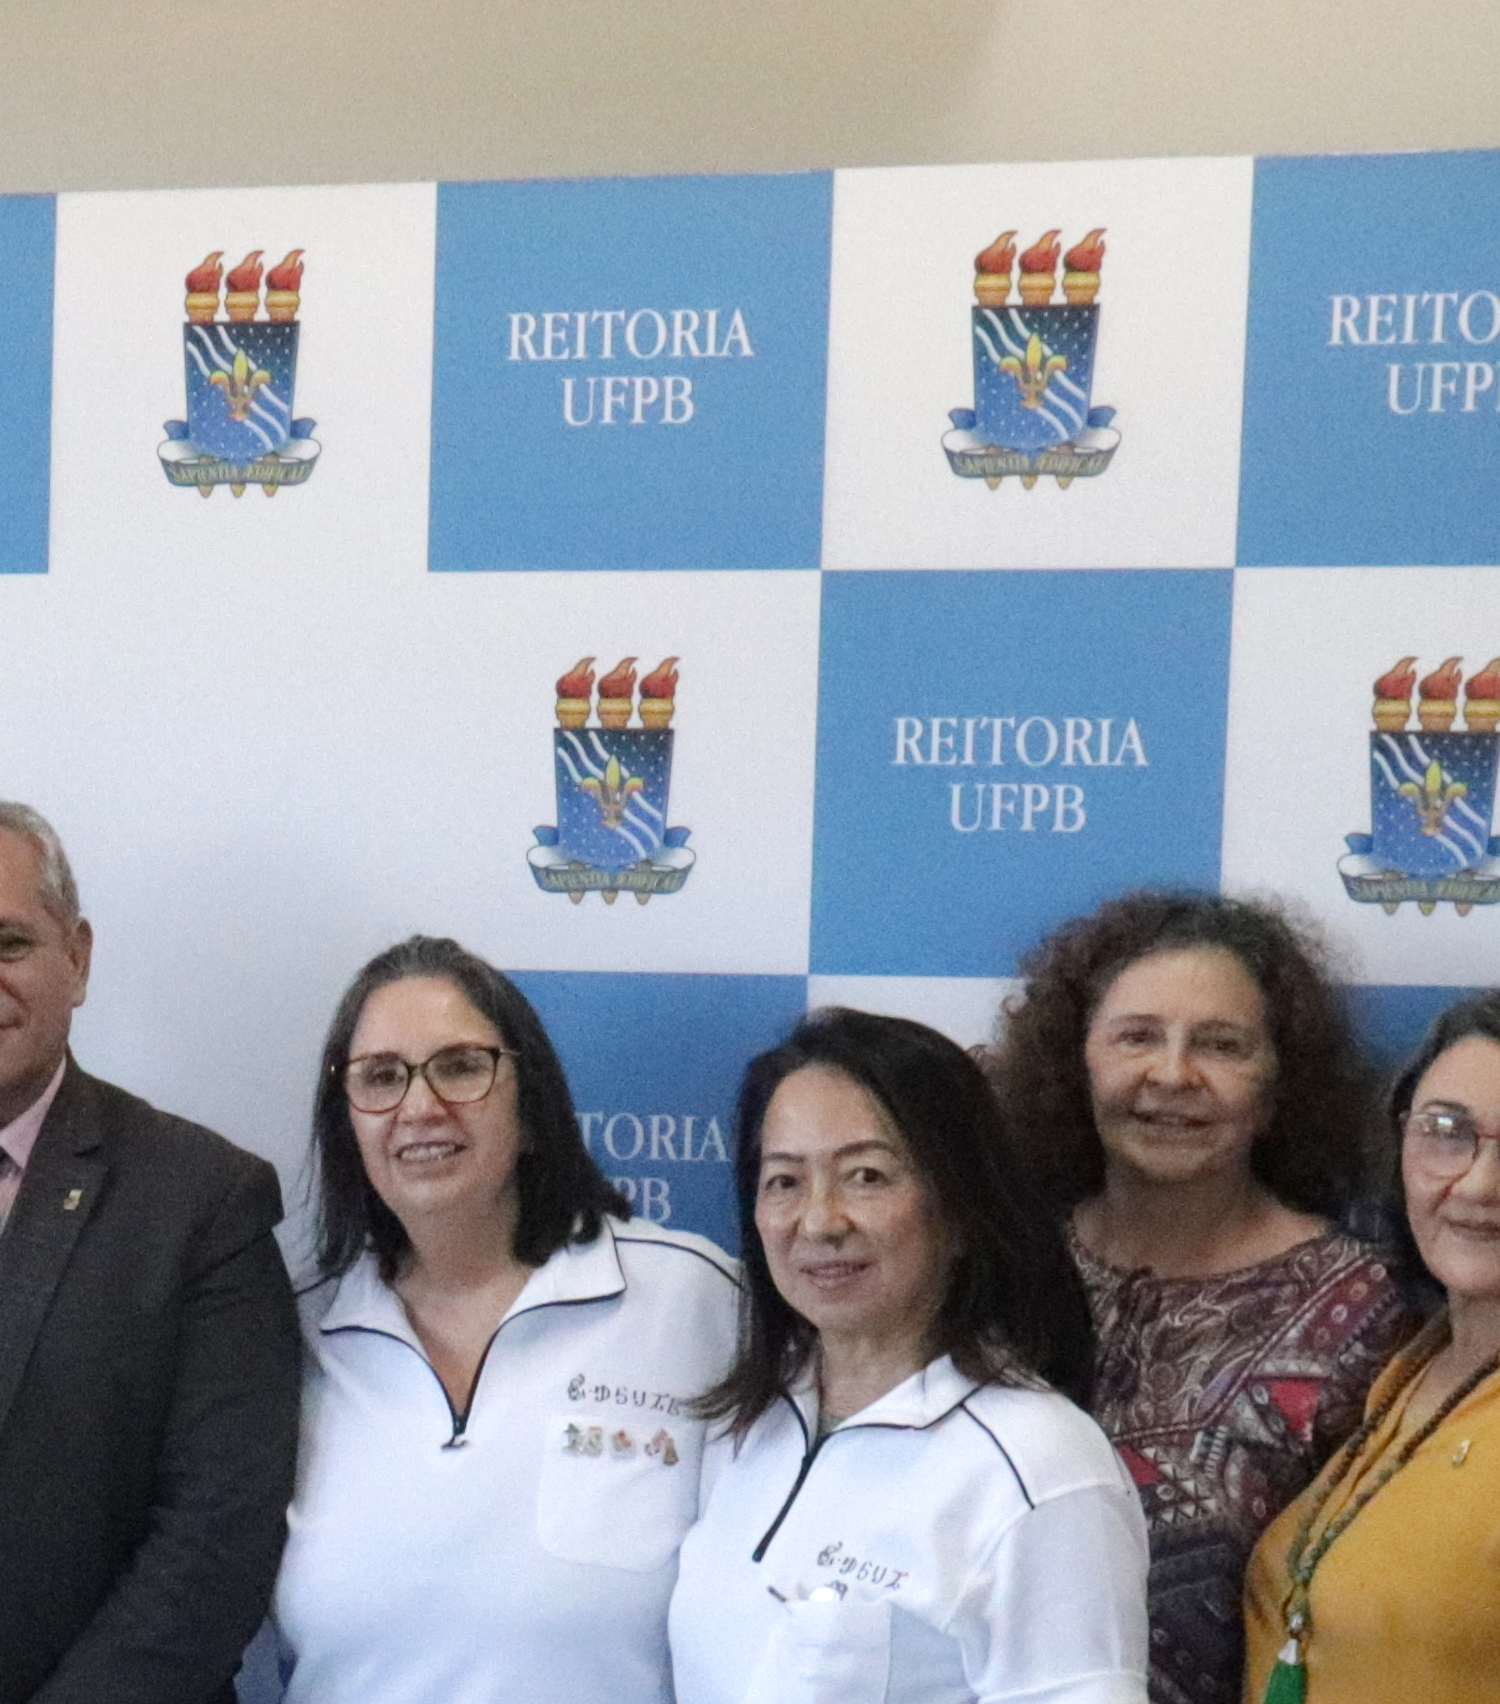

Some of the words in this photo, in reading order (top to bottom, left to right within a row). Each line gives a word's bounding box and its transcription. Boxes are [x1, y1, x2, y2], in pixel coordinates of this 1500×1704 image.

[507, 308, 756, 362] REITORIA
[562, 375, 696, 427] UFPB
[893, 715, 1149, 767] REITORIA
[949, 782, 1088, 833] UFPB
[575, 1110, 731, 1162] TORIA
